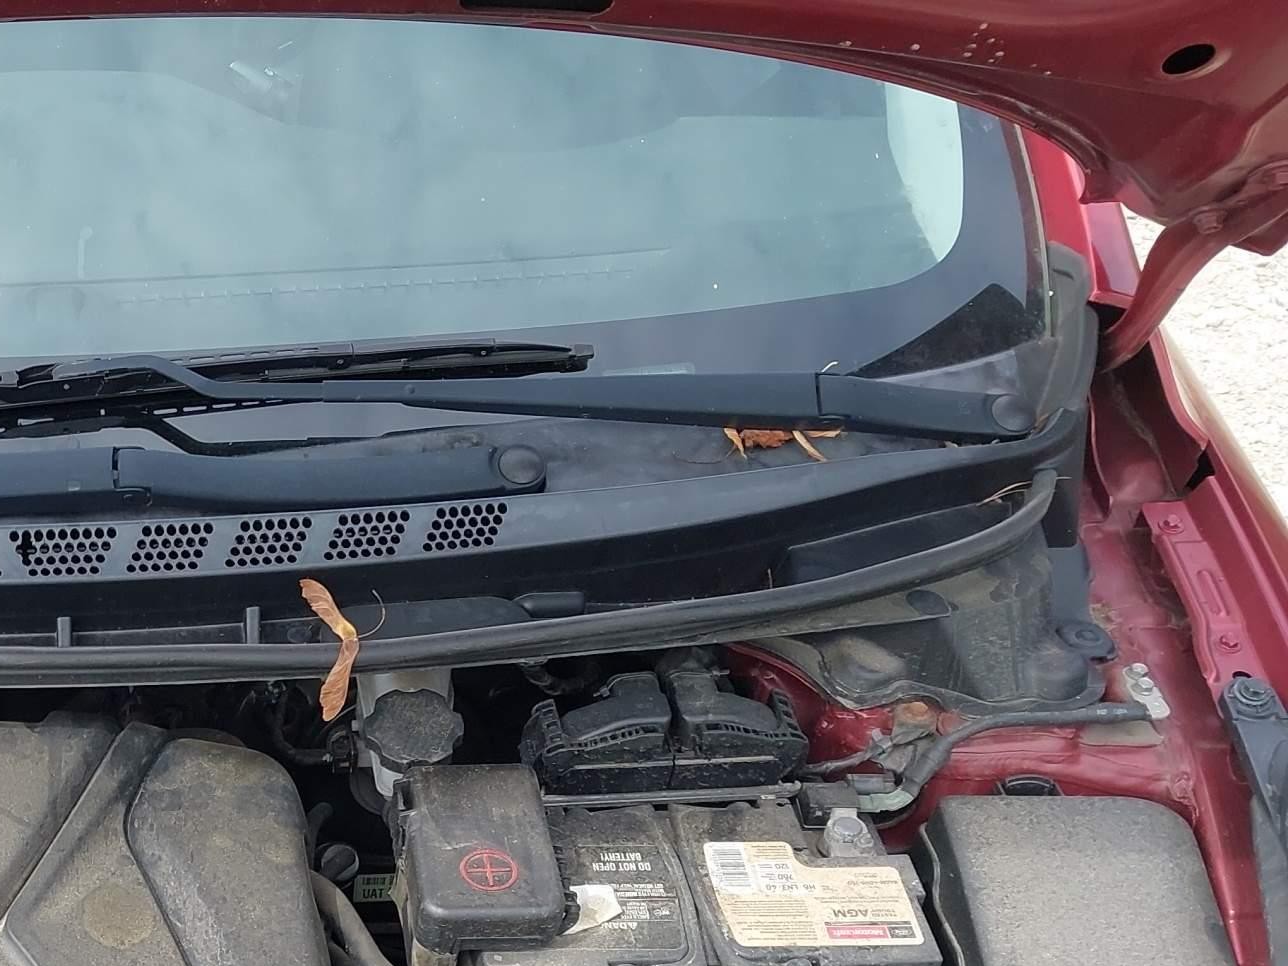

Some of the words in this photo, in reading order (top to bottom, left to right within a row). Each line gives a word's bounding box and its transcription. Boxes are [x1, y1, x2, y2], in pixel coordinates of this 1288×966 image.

[600, 852, 642, 861] BATTERY!
[592, 862, 617, 872] OPEN
[618, 862, 637, 872] NOT
[637, 862, 652, 872] DO
[362, 888, 385, 899] UAT
[832, 908, 868, 918] AGM
